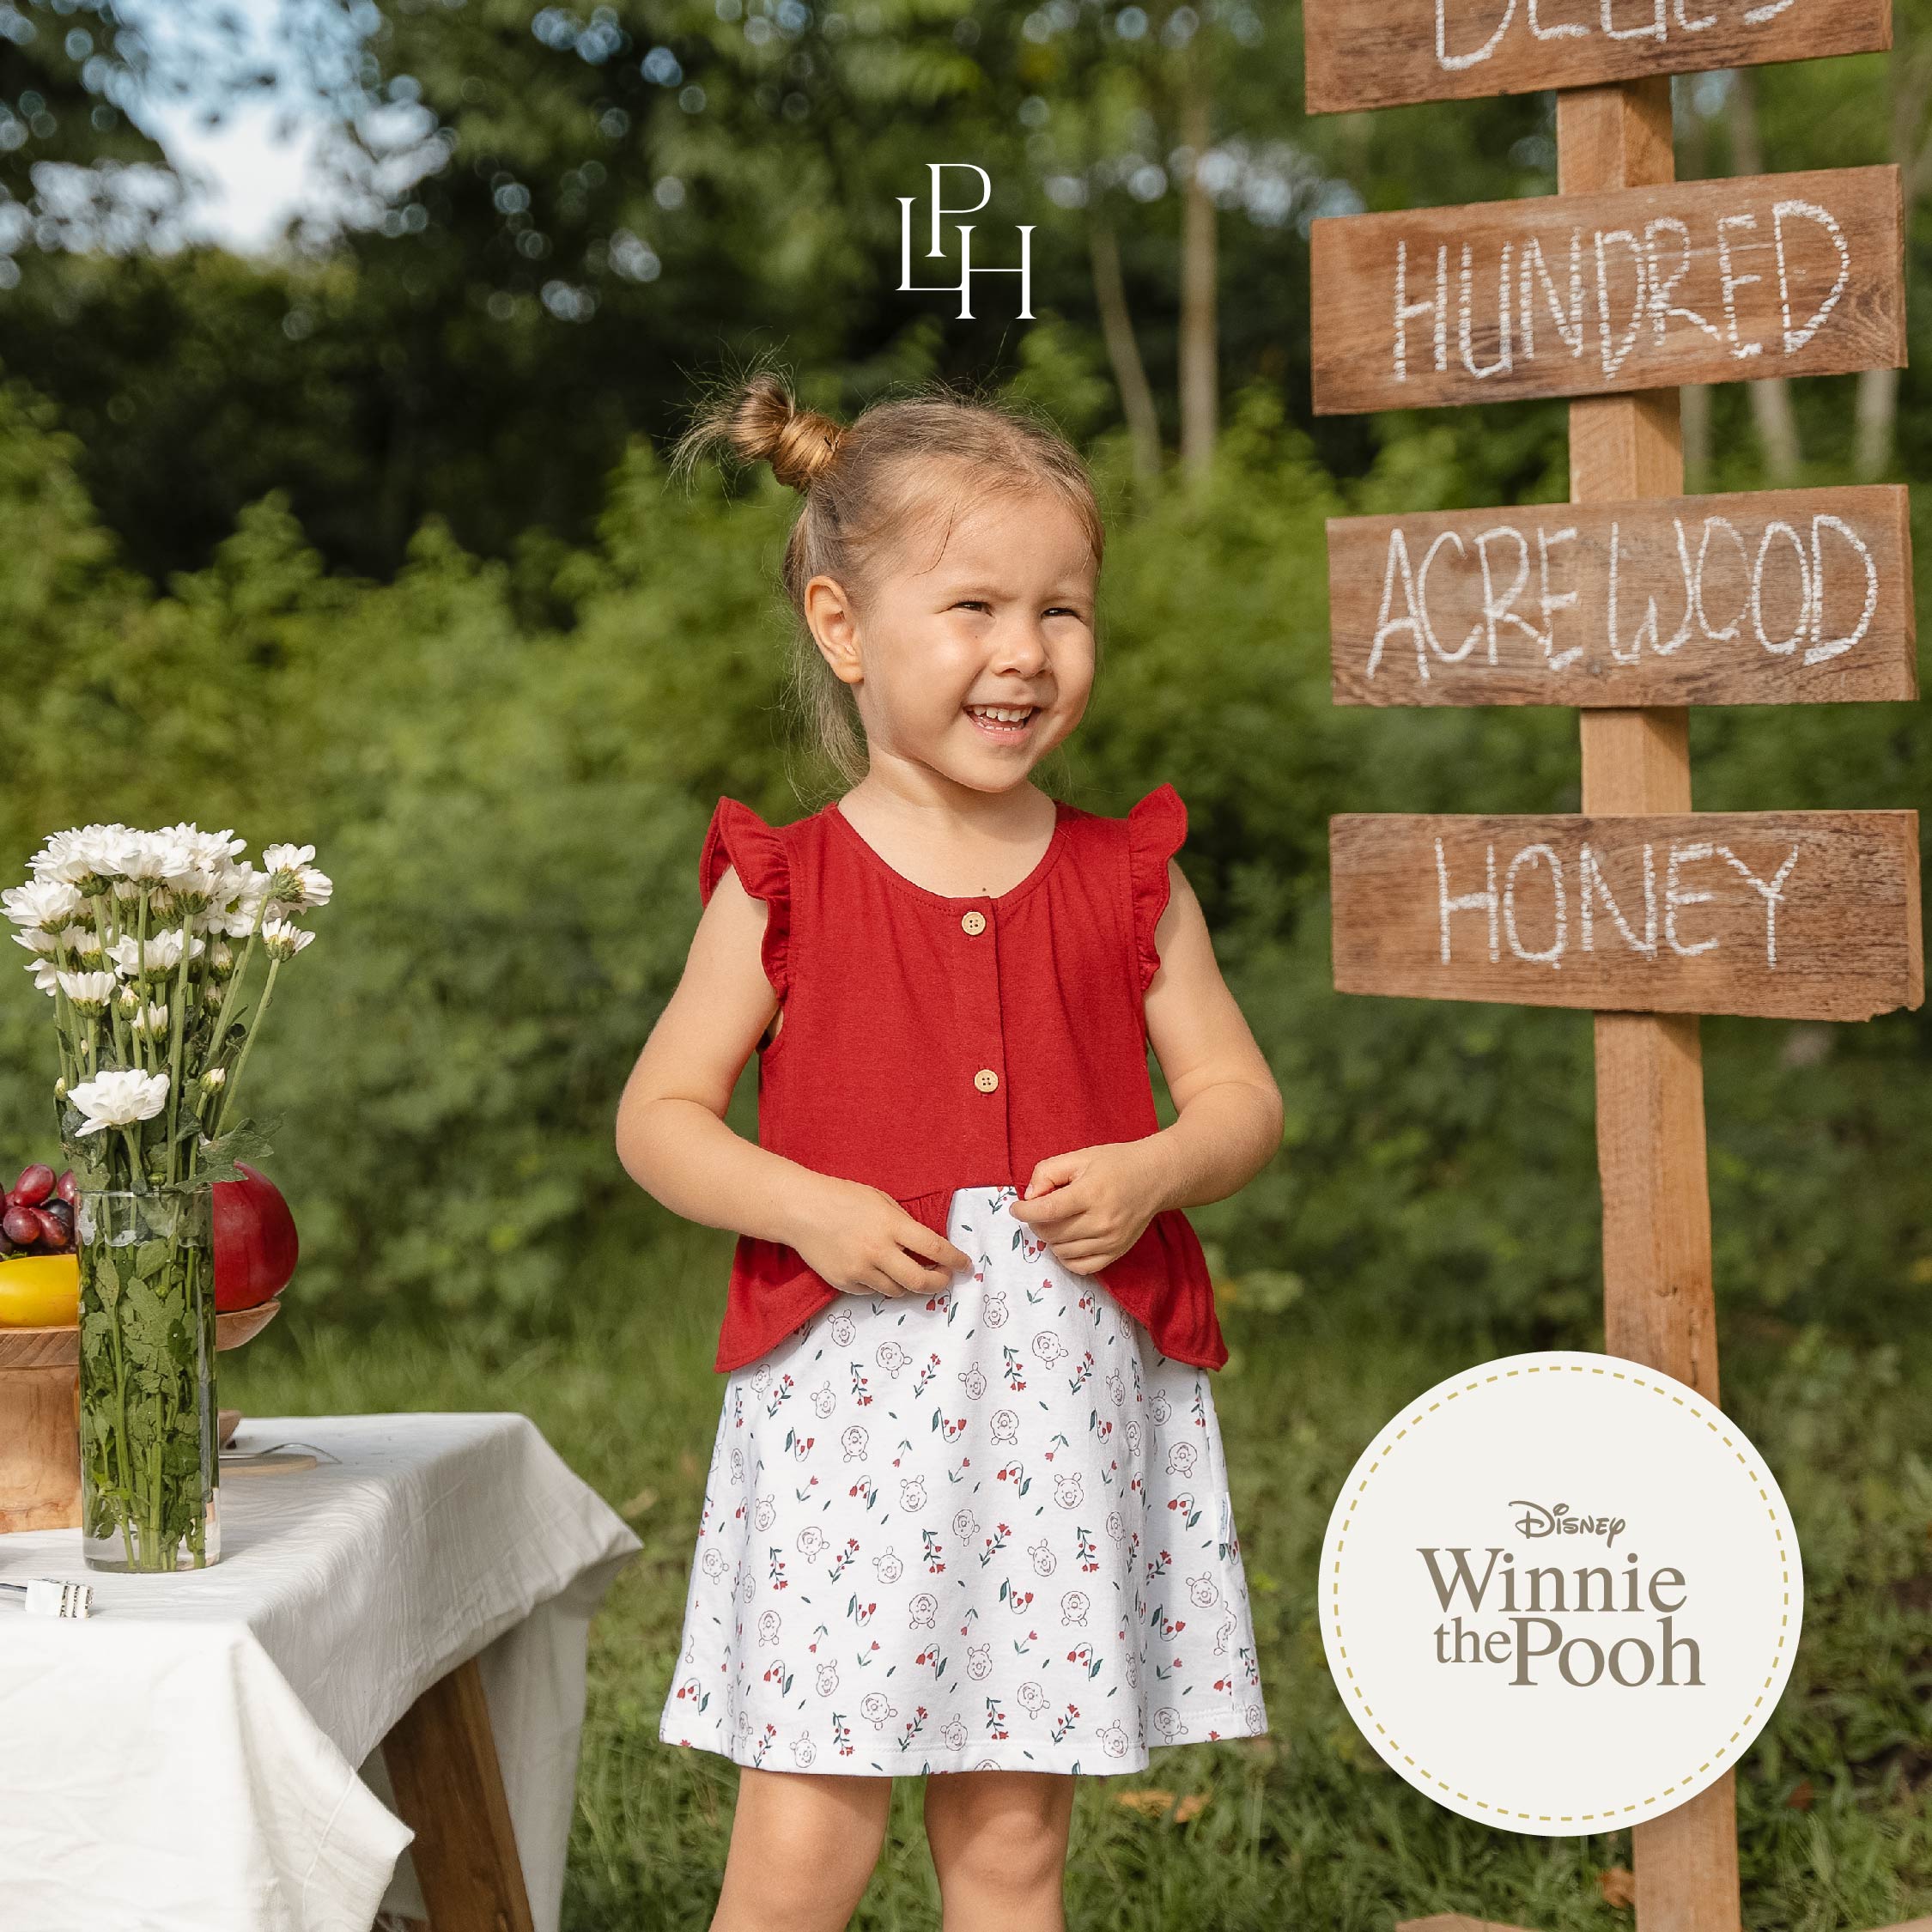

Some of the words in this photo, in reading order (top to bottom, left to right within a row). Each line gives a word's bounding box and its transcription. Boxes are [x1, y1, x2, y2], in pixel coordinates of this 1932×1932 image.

[1393, 199, 1850, 382] HUNDRED
[1368, 526, 1583, 679] ACRE
[1435, 837, 1799, 969] HONEY
